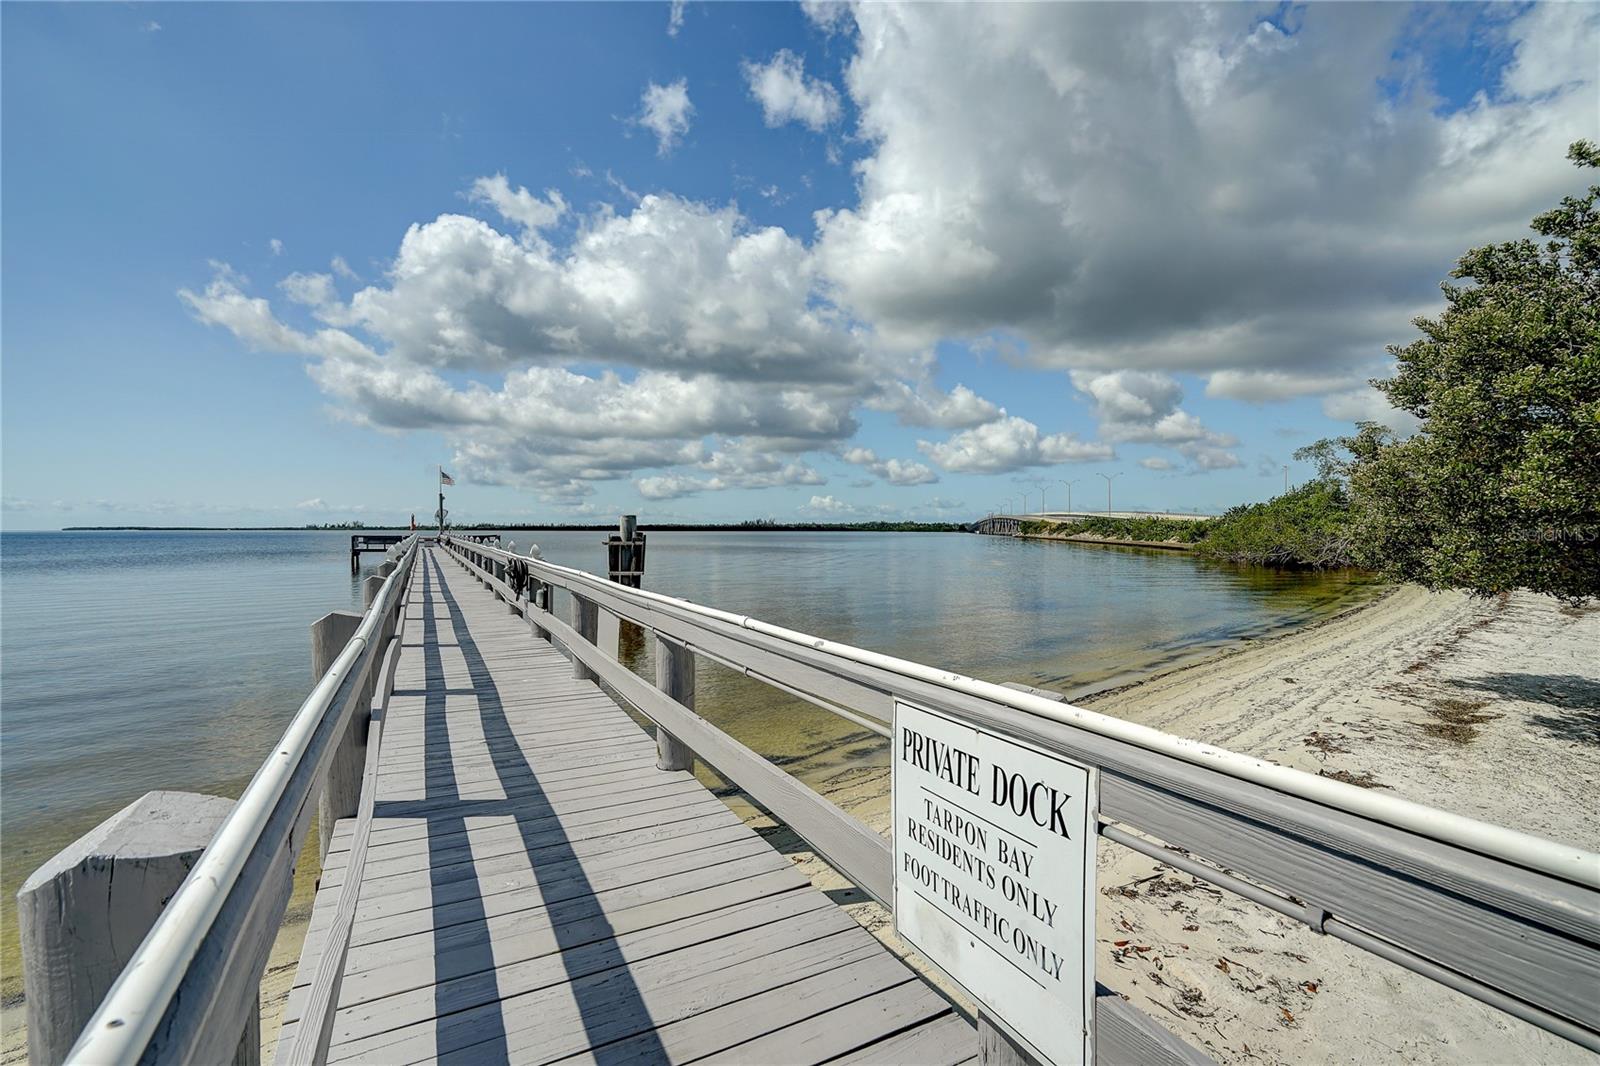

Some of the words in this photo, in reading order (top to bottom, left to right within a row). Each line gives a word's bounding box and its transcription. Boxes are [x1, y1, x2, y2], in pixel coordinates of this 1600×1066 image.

[902, 726, 980, 797] PRIVATE
[991, 763, 1073, 841] DOCK
[924, 798, 988, 854] TARPON
[998, 837, 1035, 879] BAY
[904, 852, 940, 893] FOOT
[941, 877, 1010, 944] TRAFFIC
[1013, 927, 1065, 982] ONLY
[907, 817, 996, 890] RESIDENTS
[1002, 875, 1058, 929] ONLY
